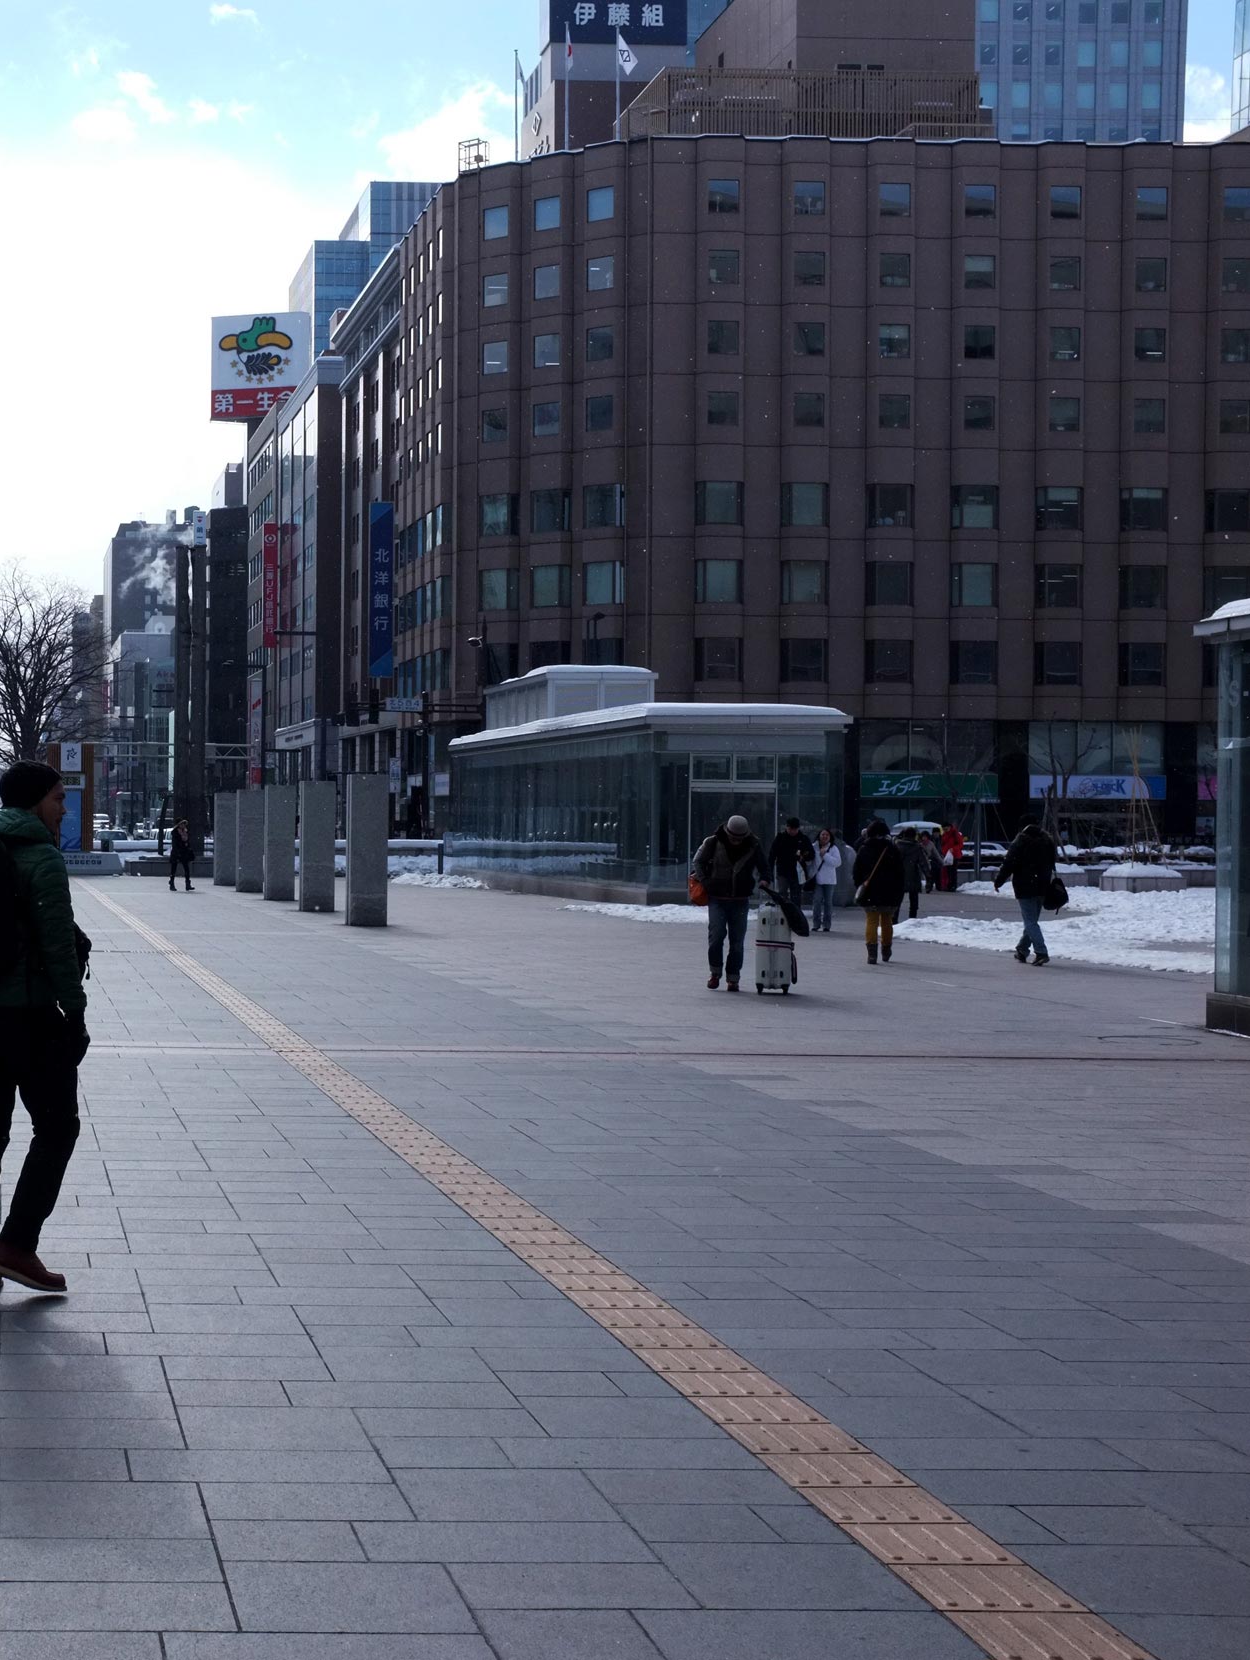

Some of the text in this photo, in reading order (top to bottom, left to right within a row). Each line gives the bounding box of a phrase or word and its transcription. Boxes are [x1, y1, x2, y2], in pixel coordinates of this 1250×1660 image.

[573, 2, 664, 27] 伊藤組
[374, 548, 390, 631] 北洋銀行
